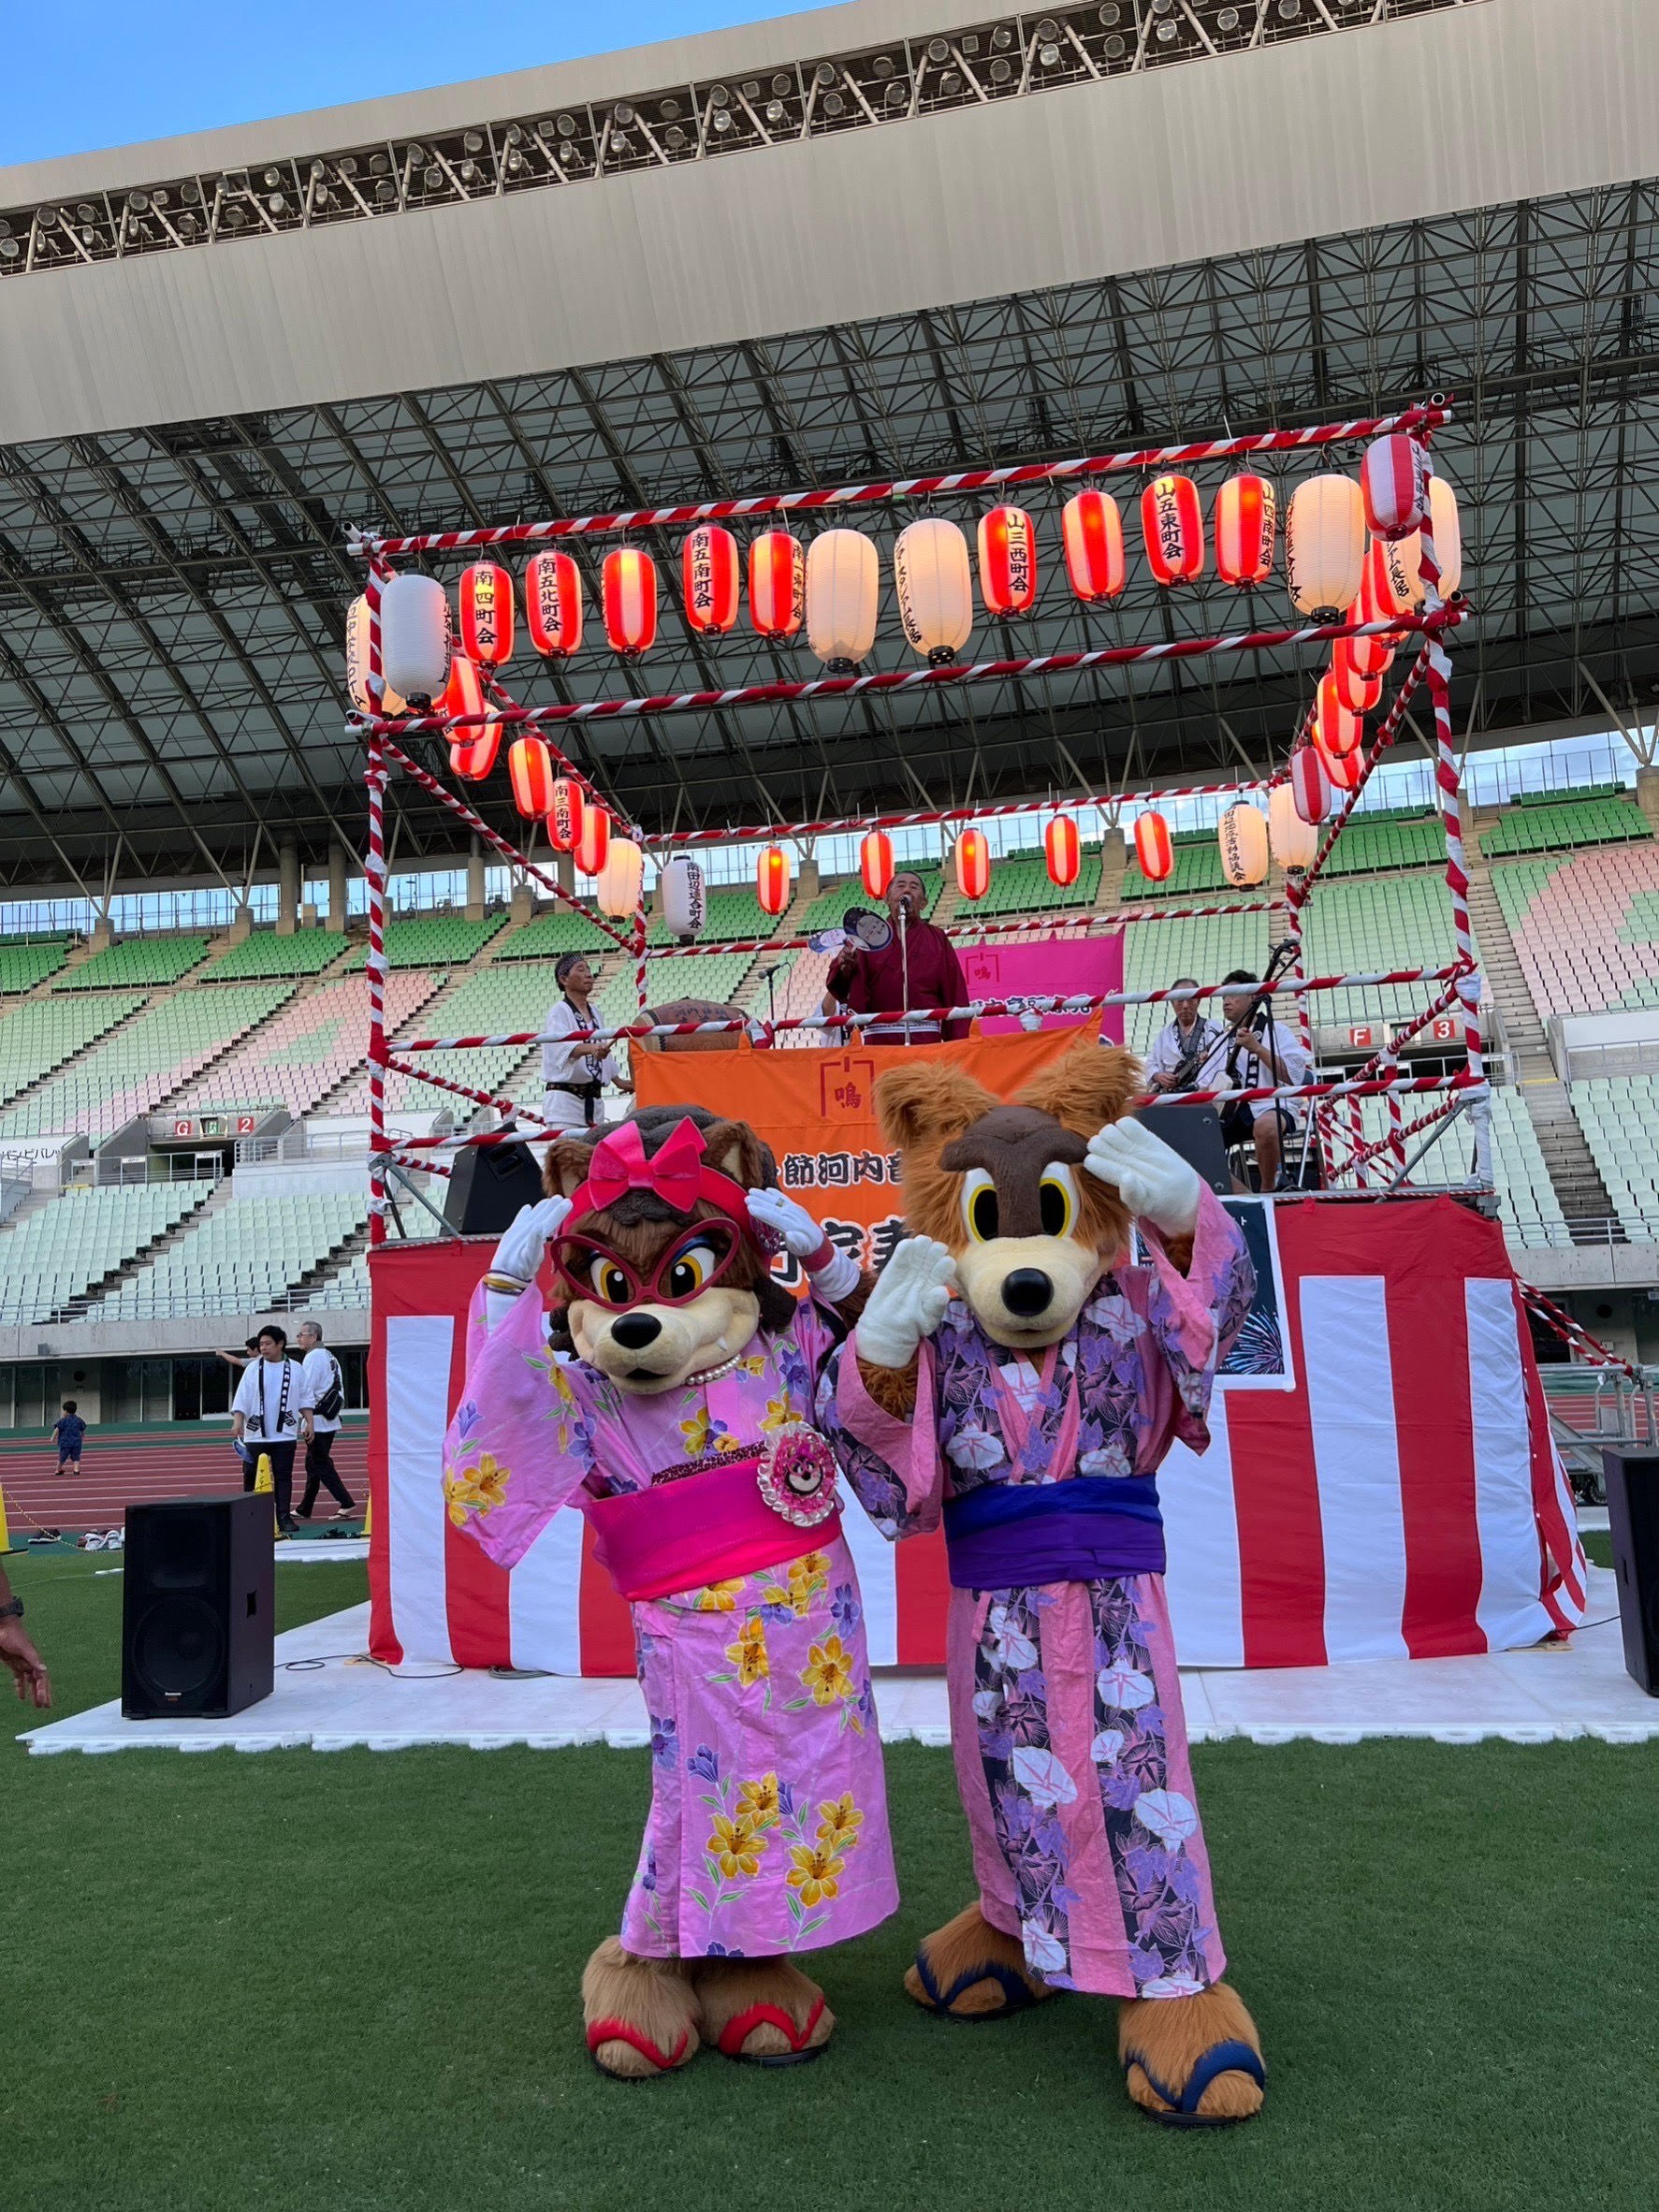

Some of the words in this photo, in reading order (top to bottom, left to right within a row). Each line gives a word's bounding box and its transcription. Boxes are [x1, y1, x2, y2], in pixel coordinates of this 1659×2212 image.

[1007, 514, 1030, 592] 山三西町会
[1156, 483, 1185, 560] 山五東町会
[538, 558, 563, 632] 南五北町会
[692, 532, 714, 608] 南五南町会
[475, 571, 498, 645] 南四町会
[555, 785, 572, 838] 南三南町会
[1353, 1028, 1367, 1046] F
[1437, 1021, 1450, 1039] 3
[176, 1121, 189, 1137] G
[240, 1117, 251, 1132] 2
[834, 1082, 862, 1108] 鳴
